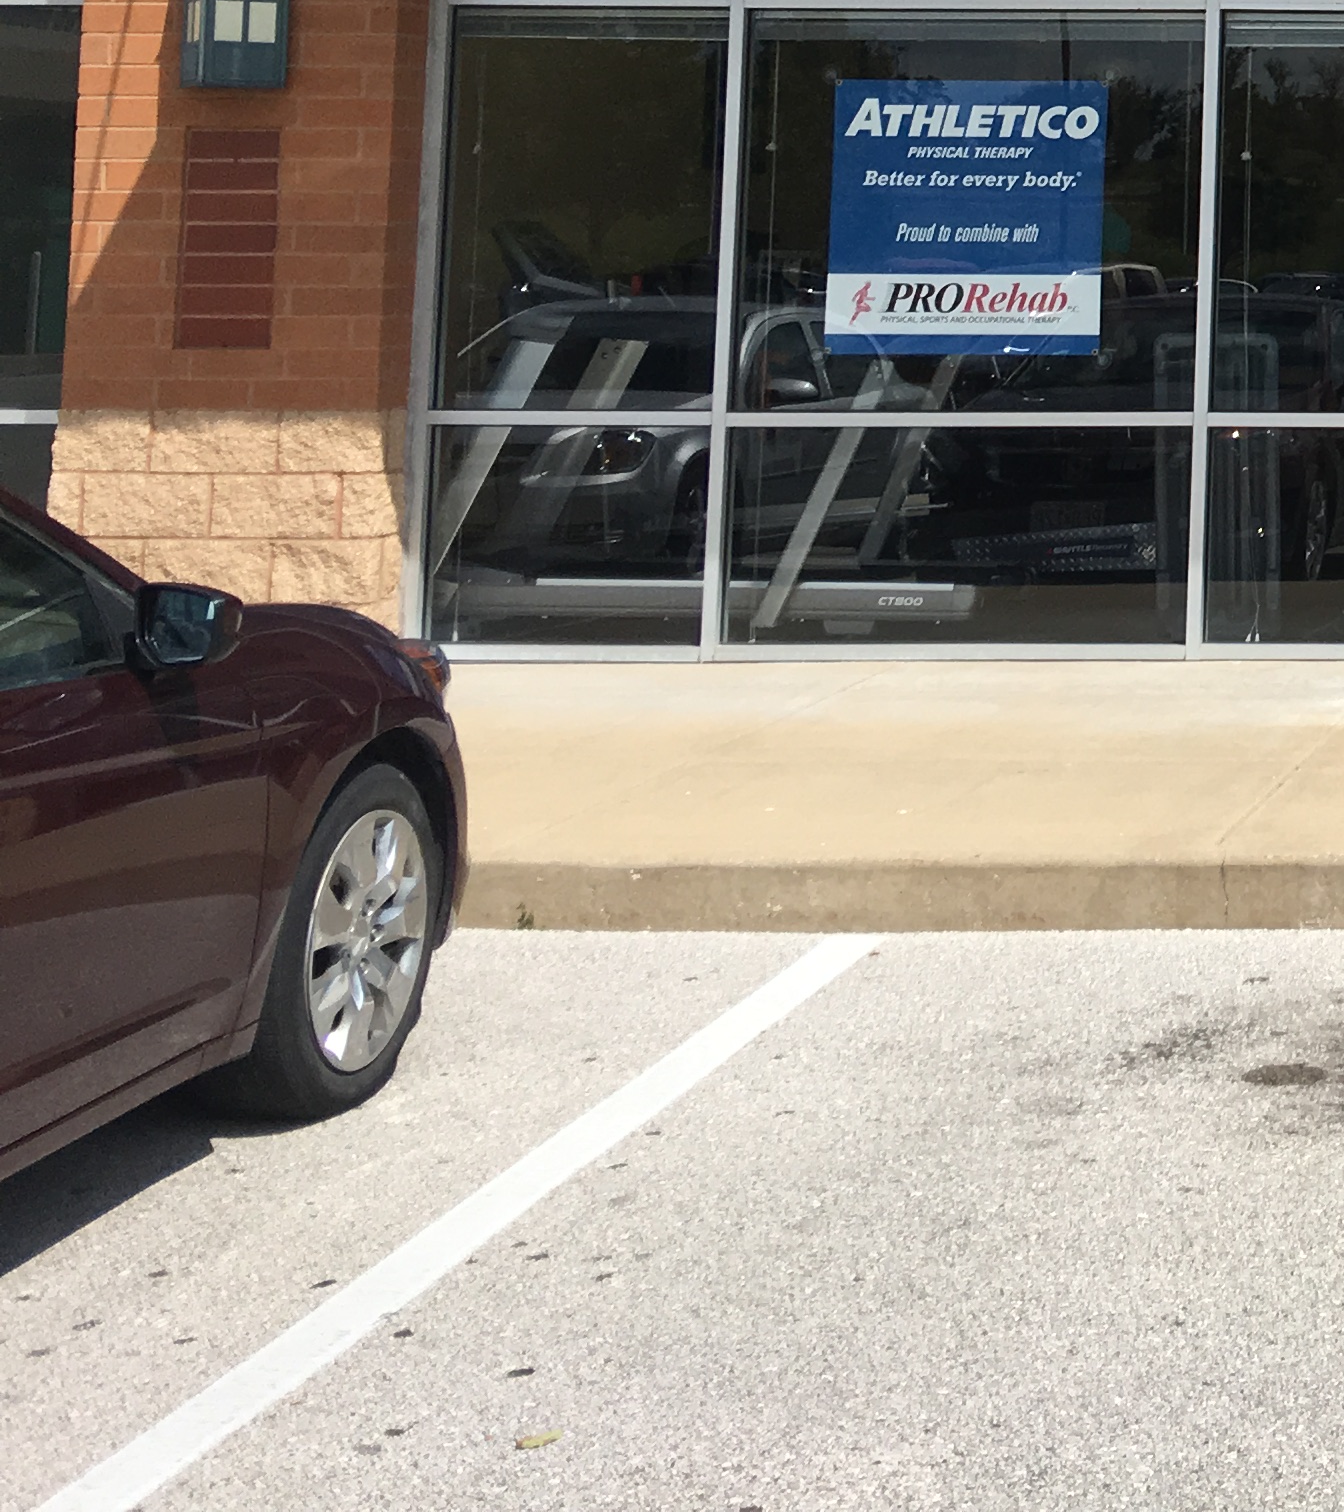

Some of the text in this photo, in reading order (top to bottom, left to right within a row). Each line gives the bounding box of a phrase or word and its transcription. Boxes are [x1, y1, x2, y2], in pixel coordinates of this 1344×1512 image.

[845, 98, 1099, 139] ATHLETICO
[907, 146, 1034, 159] PHYSICAL THERAPY
[863, 170, 926, 187] Better
[928, 170, 960, 187] for
[962, 173, 1020, 192] every
[896, 223, 1040, 243] Proud to combine with
[919, 315, 949, 324] SPORTS
[950, 315, 968, 324] AND
